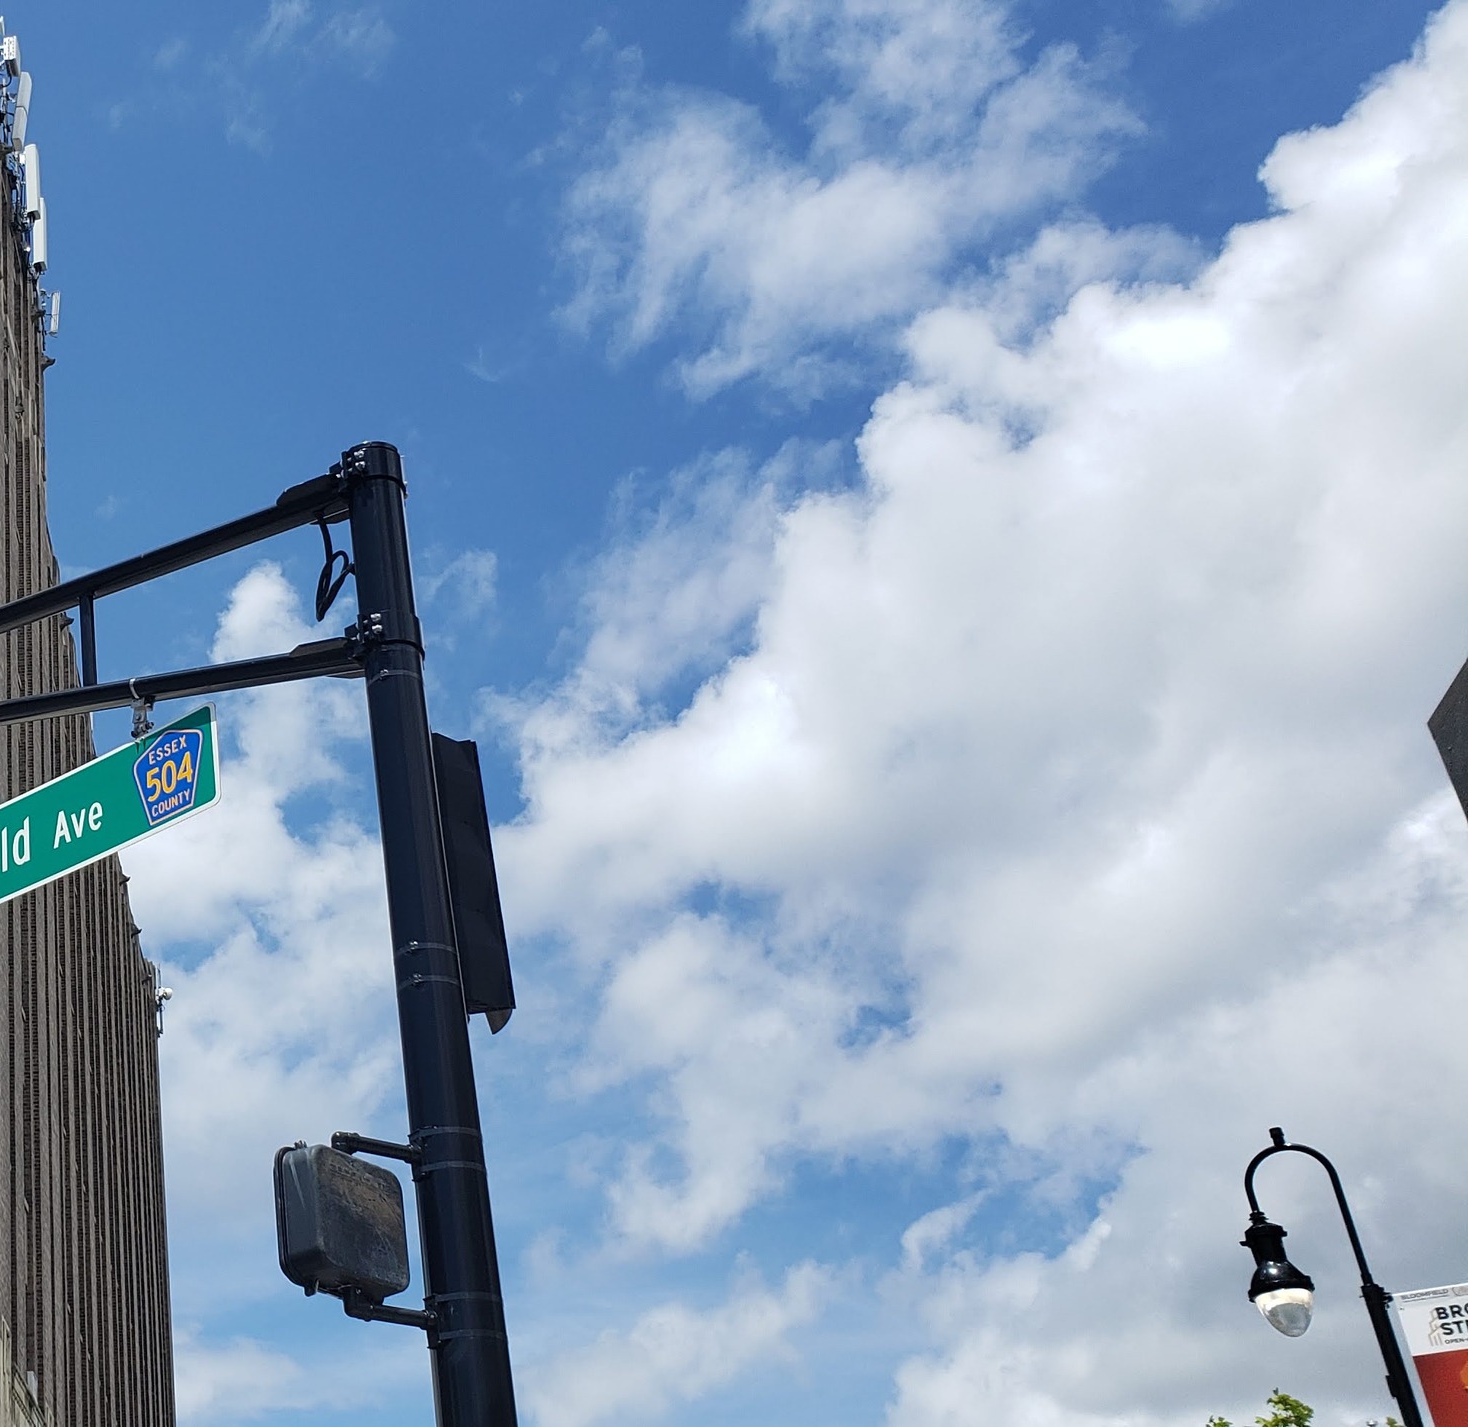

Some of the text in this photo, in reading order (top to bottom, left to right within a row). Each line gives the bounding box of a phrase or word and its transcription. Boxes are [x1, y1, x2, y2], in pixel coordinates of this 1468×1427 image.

[148, 735, 187, 765] ESSEX
[146, 751, 193, 802] 504
[152, 788, 191, 817] COUNTY
[53, 801, 103, 849] Ave
[1435, 1303, 1468, 1320] BR
[1440, 1320, 1468, 1335] ST
